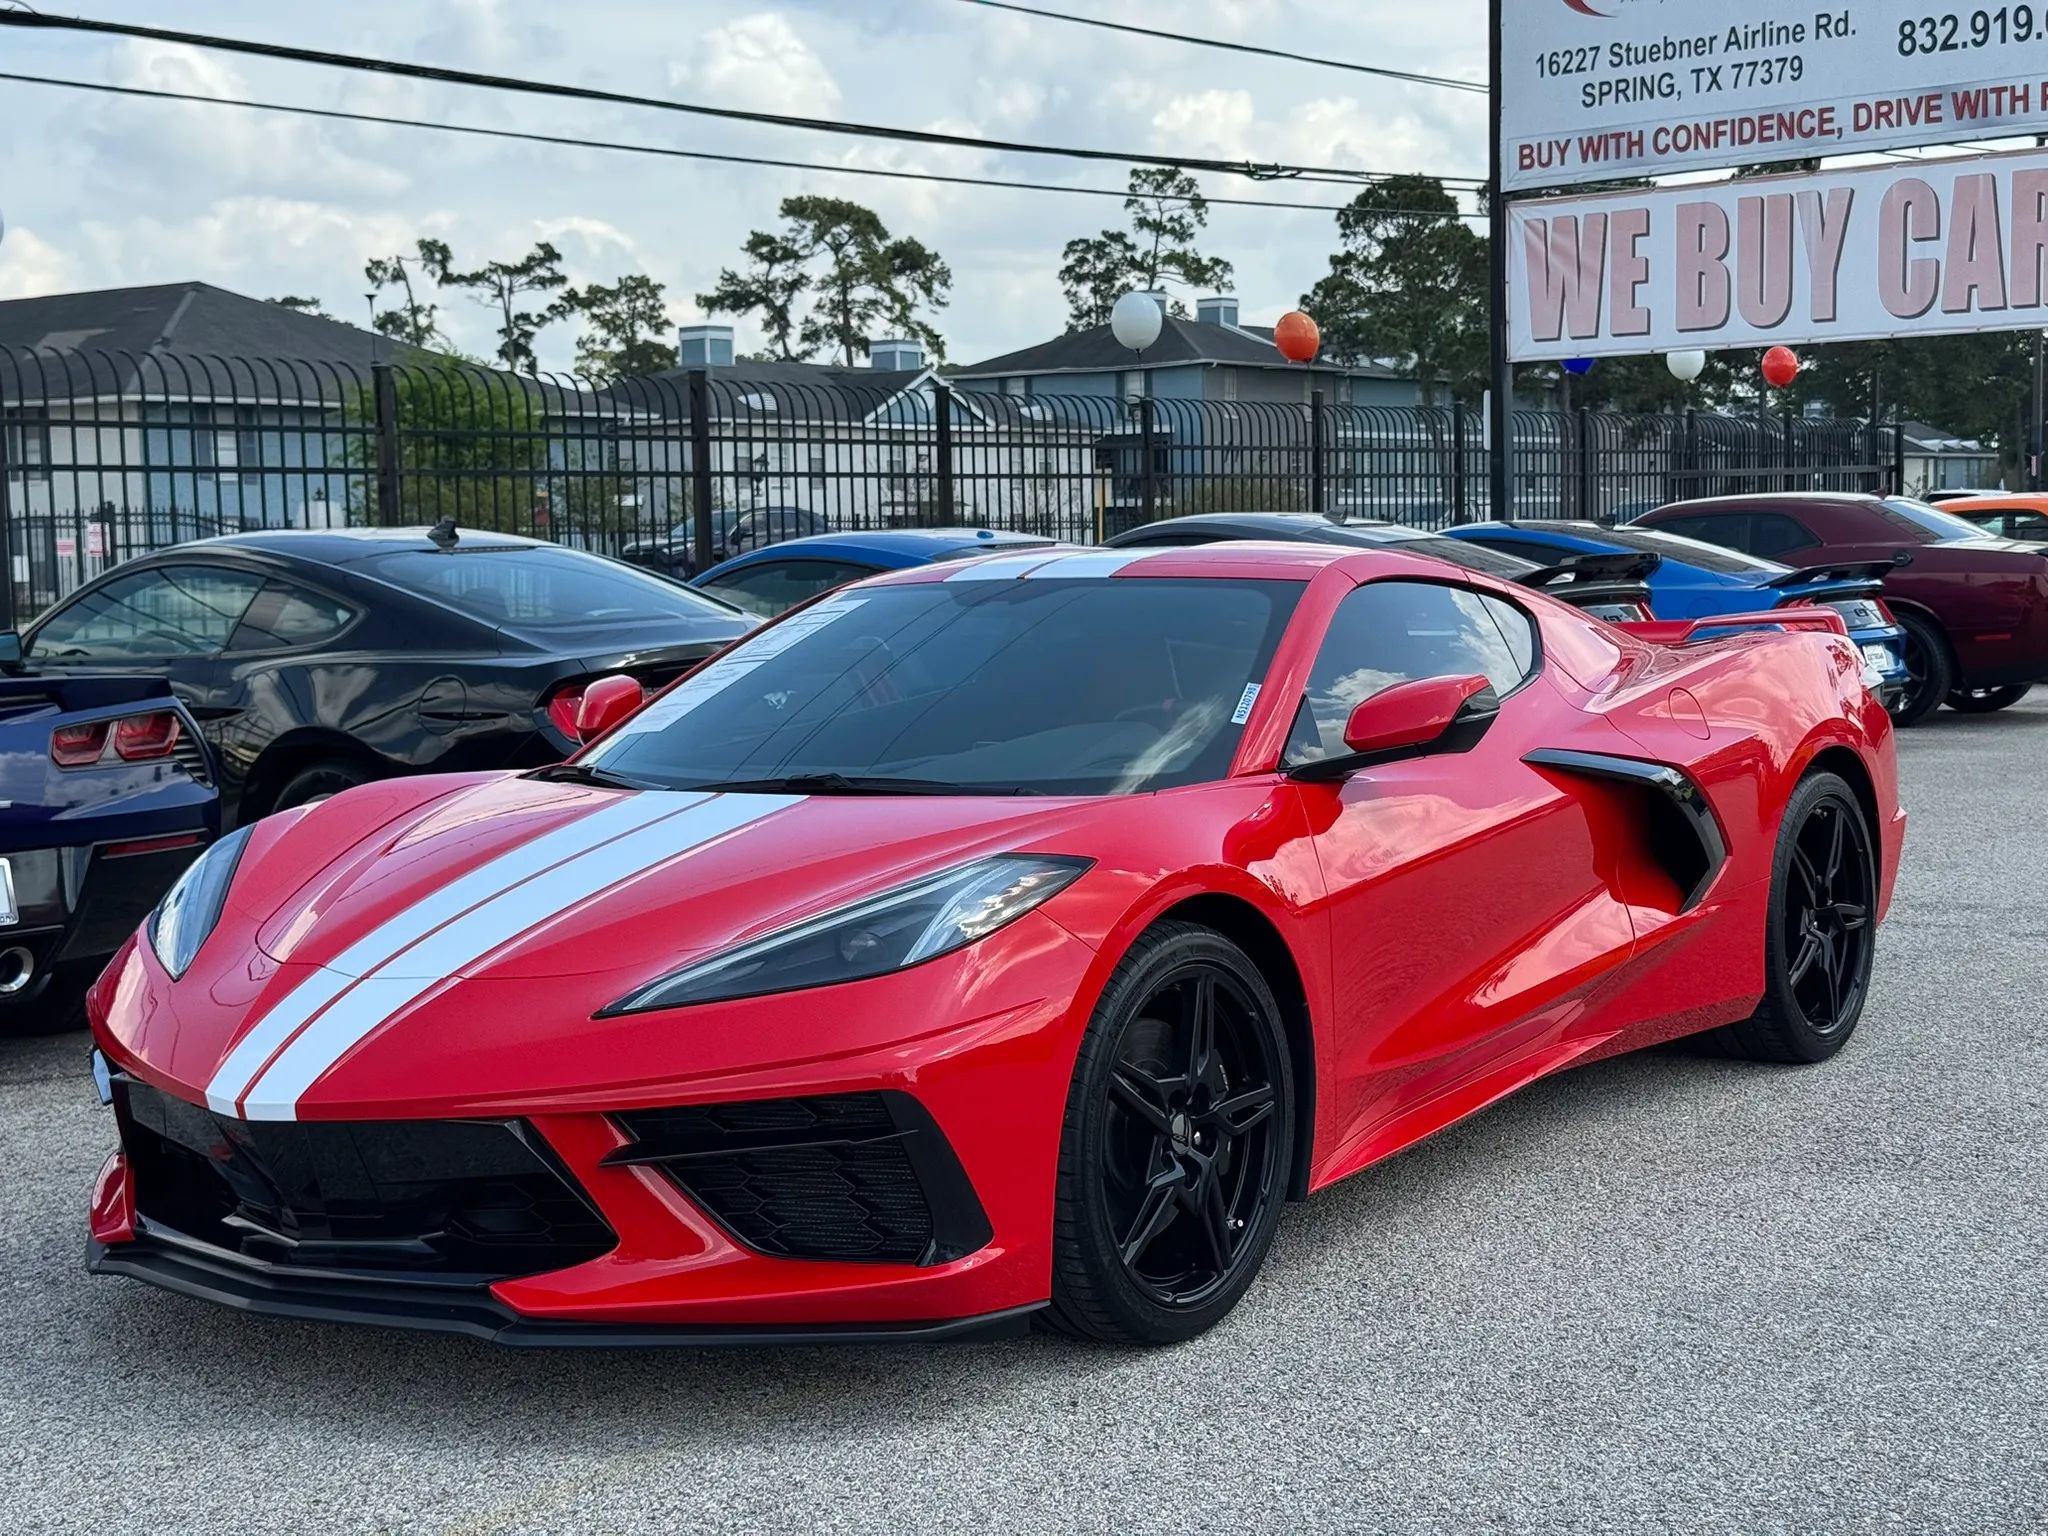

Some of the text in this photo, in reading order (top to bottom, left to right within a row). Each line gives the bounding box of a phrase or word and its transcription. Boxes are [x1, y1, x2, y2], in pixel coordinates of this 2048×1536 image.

[1536, 10, 1856, 78] 16227 Stuebner Airline Rd.
[1898, 5, 2048, 56] 832.919.
[1582, 56, 1803, 108] SPRING, TX 77379
[1518, 138, 1571, 171] BUY
[1578, 130, 1643, 164] WITH
[1652, 107, 1842, 155] CONFIDENCE,
[1853, 94, 1942, 132] DRIVE
[1951, 83, 2029, 120] WITH
[1524, 208, 1650, 342] WE
[1676, 187, 1854, 333] BUY
